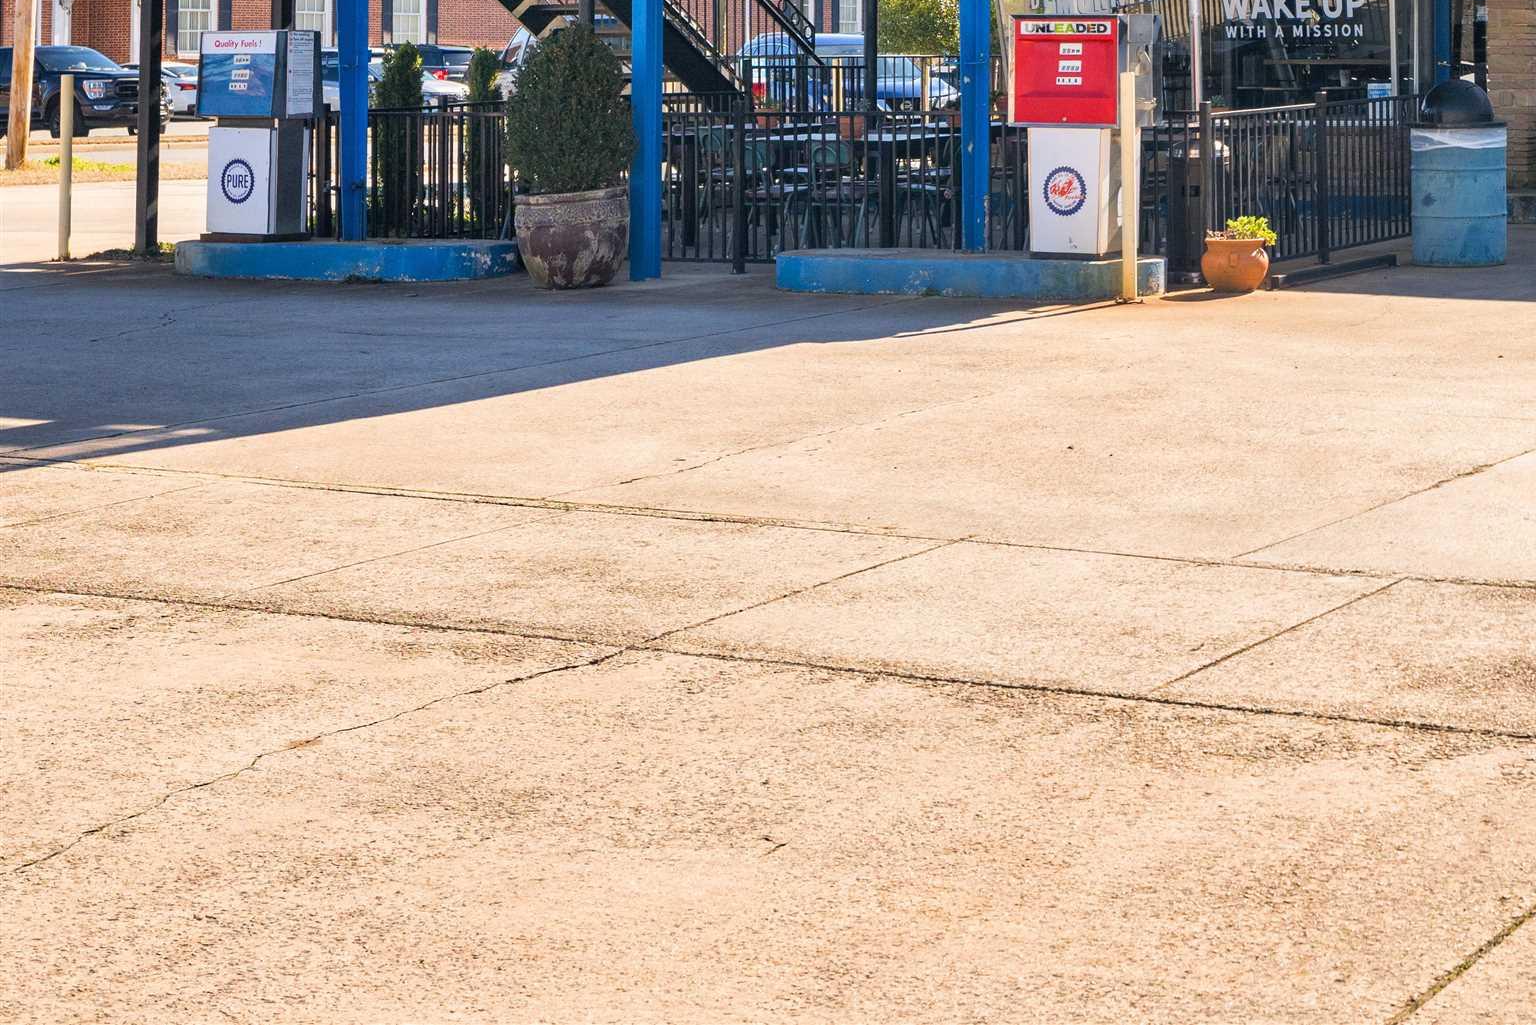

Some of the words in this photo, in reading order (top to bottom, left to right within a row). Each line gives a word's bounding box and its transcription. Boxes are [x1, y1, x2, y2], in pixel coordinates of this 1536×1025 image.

[1024, 23, 1108, 34] UNLEADED
[1225, 25, 1266, 38] WITH
[1275, 25, 1284, 38] A
[1293, 23, 1364, 38] MISSION
[214, 39, 238, 49] Quality
[226, 174, 249, 189] PURE
